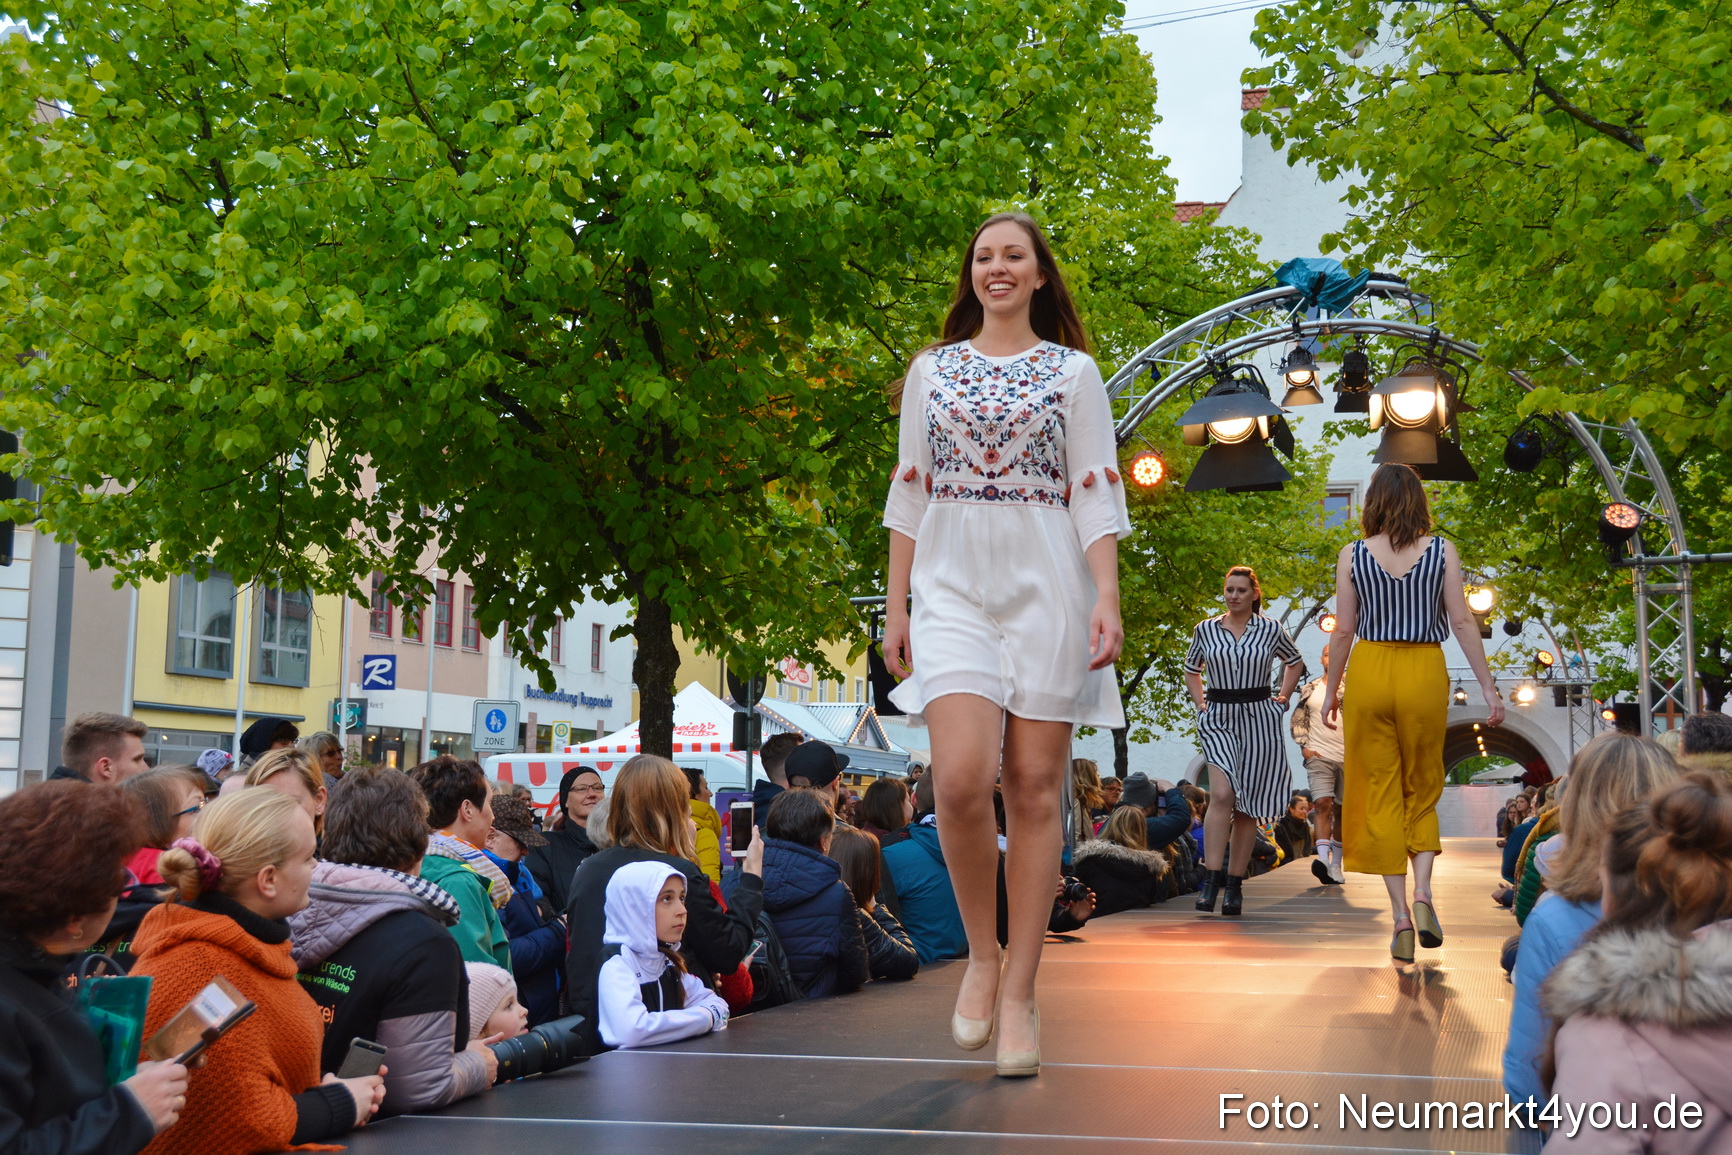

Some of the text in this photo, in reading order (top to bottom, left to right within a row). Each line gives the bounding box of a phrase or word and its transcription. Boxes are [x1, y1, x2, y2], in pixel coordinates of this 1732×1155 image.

[579, 691, 613, 709] Rupprecht
[484, 737, 505, 746] ZONE
[313, 976, 325, 985] von
[325, 977, 351, 993] Wäsche
